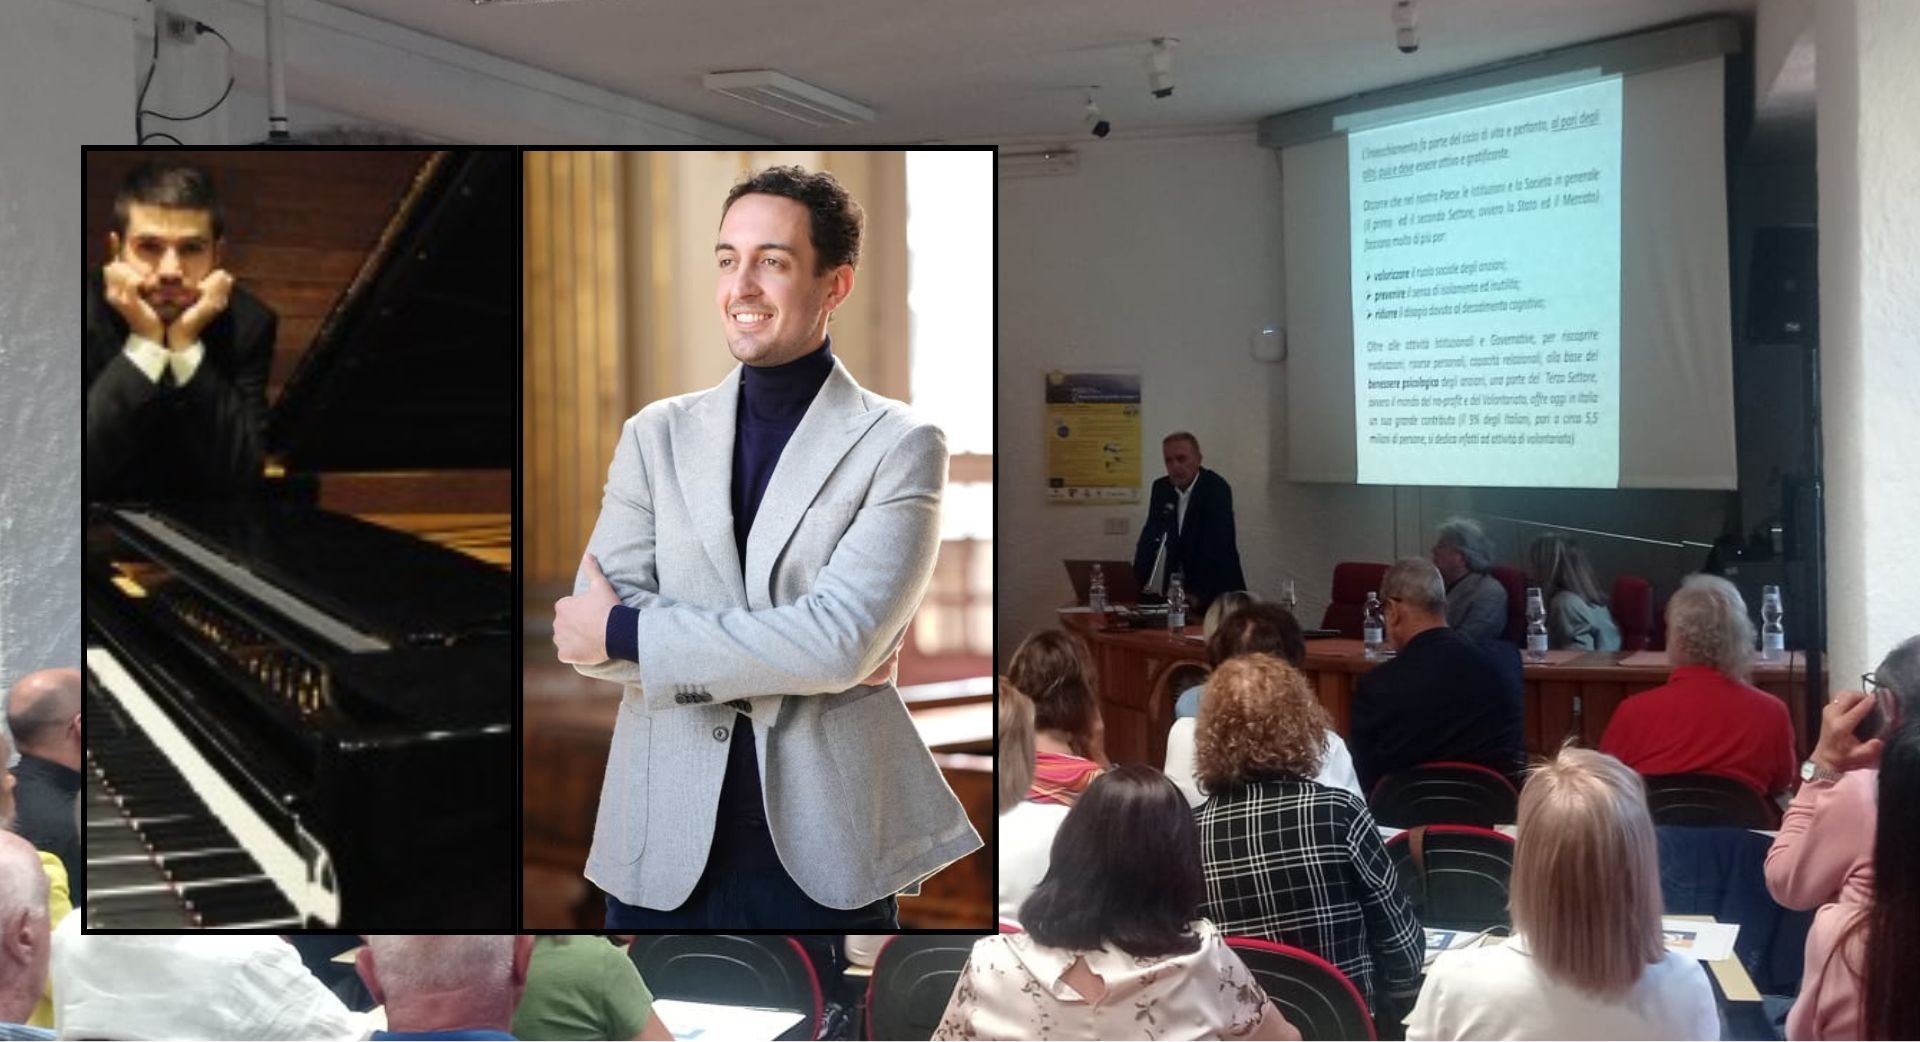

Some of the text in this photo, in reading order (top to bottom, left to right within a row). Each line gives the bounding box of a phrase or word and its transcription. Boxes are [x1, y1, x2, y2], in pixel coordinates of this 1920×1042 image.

[1579, 108, 1600, 127] degli
[1564, 167, 1600, 188] generale
[1517, 199, 1537, 212] Stato
[1540, 196, 1551, 210] ed
[1374, 268, 1410, 281] valorizzare
[1435, 263, 1459, 276] sociale
[1460, 260, 1478, 275] degli
[1374, 288, 1406, 303] prevenire
[1564, 350, 1583, 362] base
[1586, 349, 1599, 361] del
[1368, 378, 1400, 389] benessere
[1402, 376, 1439, 391] psicologico
[1505, 374, 1526, 387] parte
[1545, 371, 1565, 384] Terzo
